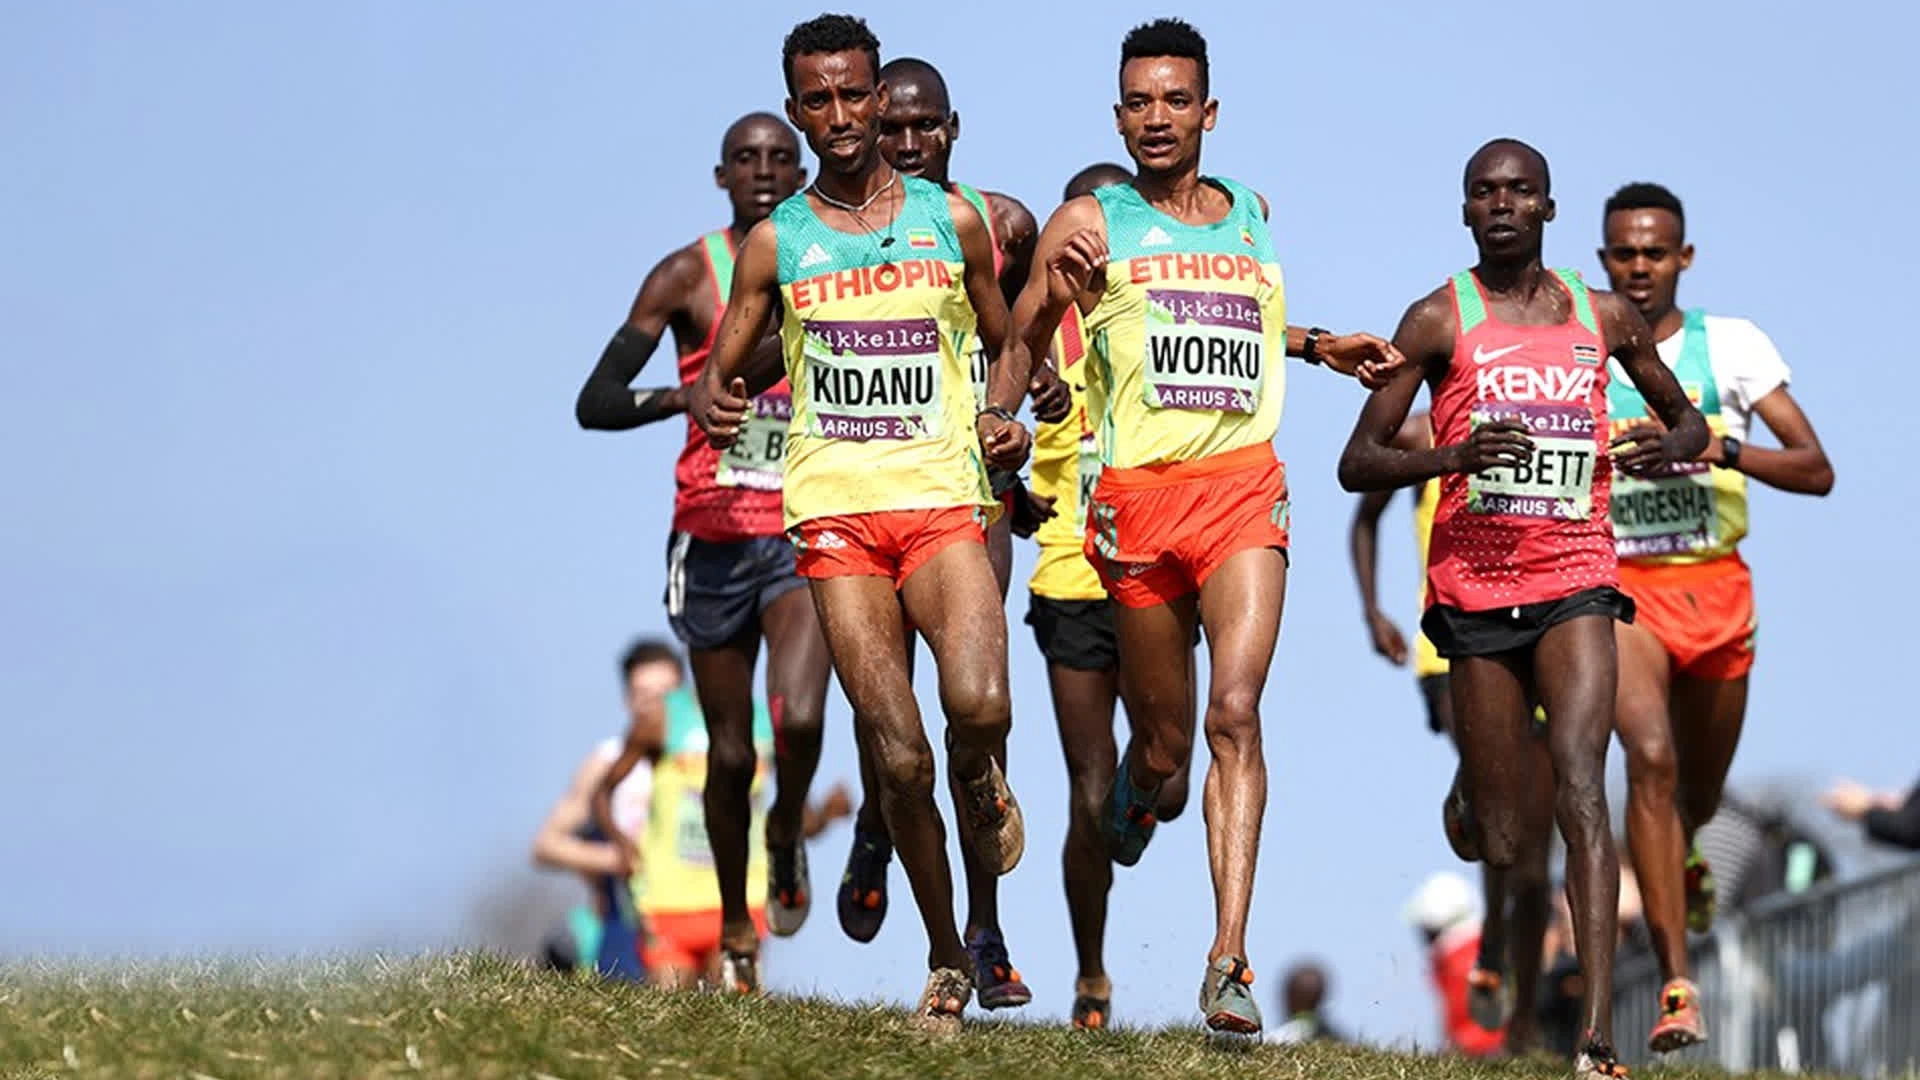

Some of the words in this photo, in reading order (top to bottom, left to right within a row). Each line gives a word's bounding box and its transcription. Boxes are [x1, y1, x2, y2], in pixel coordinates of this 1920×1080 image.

[791, 259, 953, 311] ETHIOPIA
[808, 328, 938, 348] Mikkeller
[1151, 334, 1260, 381] WORKU
[812, 365, 934, 406] KIDANU
[1477, 366, 1597, 403] KENYA
[1514, 449, 1590, 488] BETT
